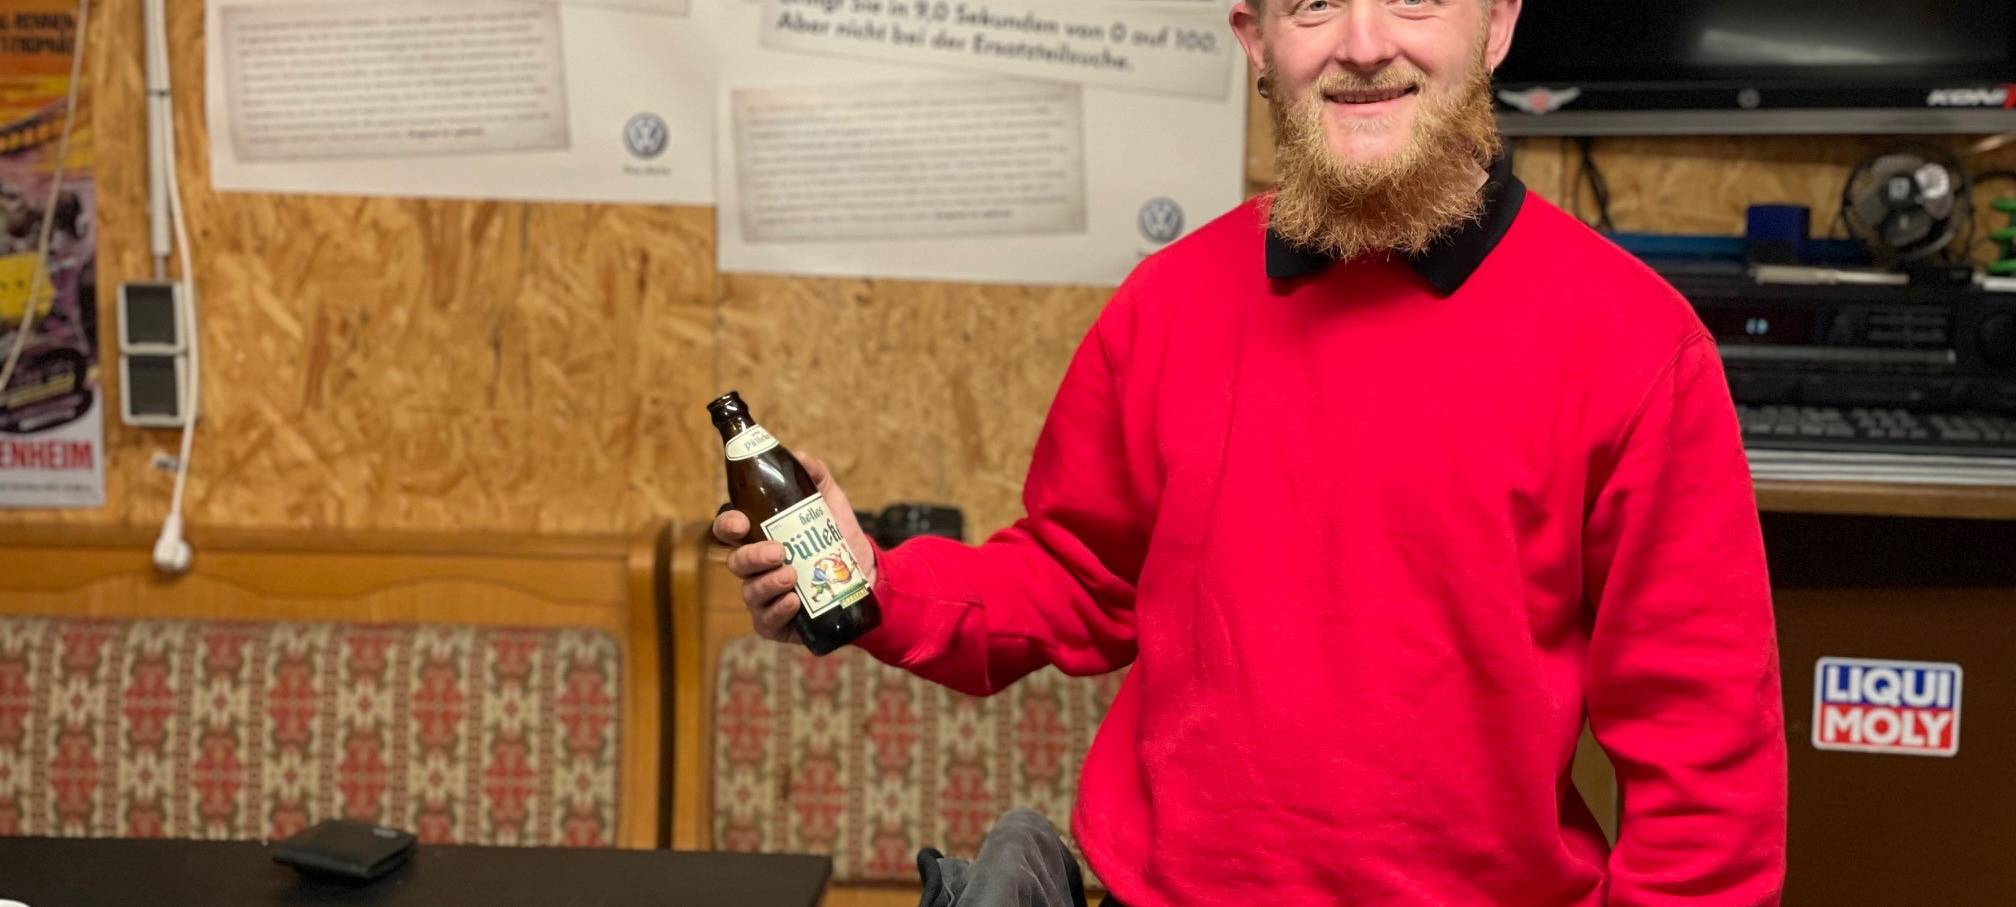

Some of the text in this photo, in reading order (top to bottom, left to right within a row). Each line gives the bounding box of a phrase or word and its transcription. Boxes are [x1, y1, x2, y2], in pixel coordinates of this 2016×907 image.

[777, 11, 829, 34] Aber
[834, 18, 886, 41] nicht
[891, 22, 927, 46] bei
[931, 29, 967, 49] der
[956, 4, 1059, 34] Sekunden
[1064, 22, 1104, 39] von
[1110, 21, 1127, 43] 0
[1132, 25, 1170, 46] auf
[1175, 28, 1221, 54] 100.
[798, 506, 823, 526] helles
[1825, 666, 1951, 707] LIQUI
[1823, 705, 1953, 747] MOLY
